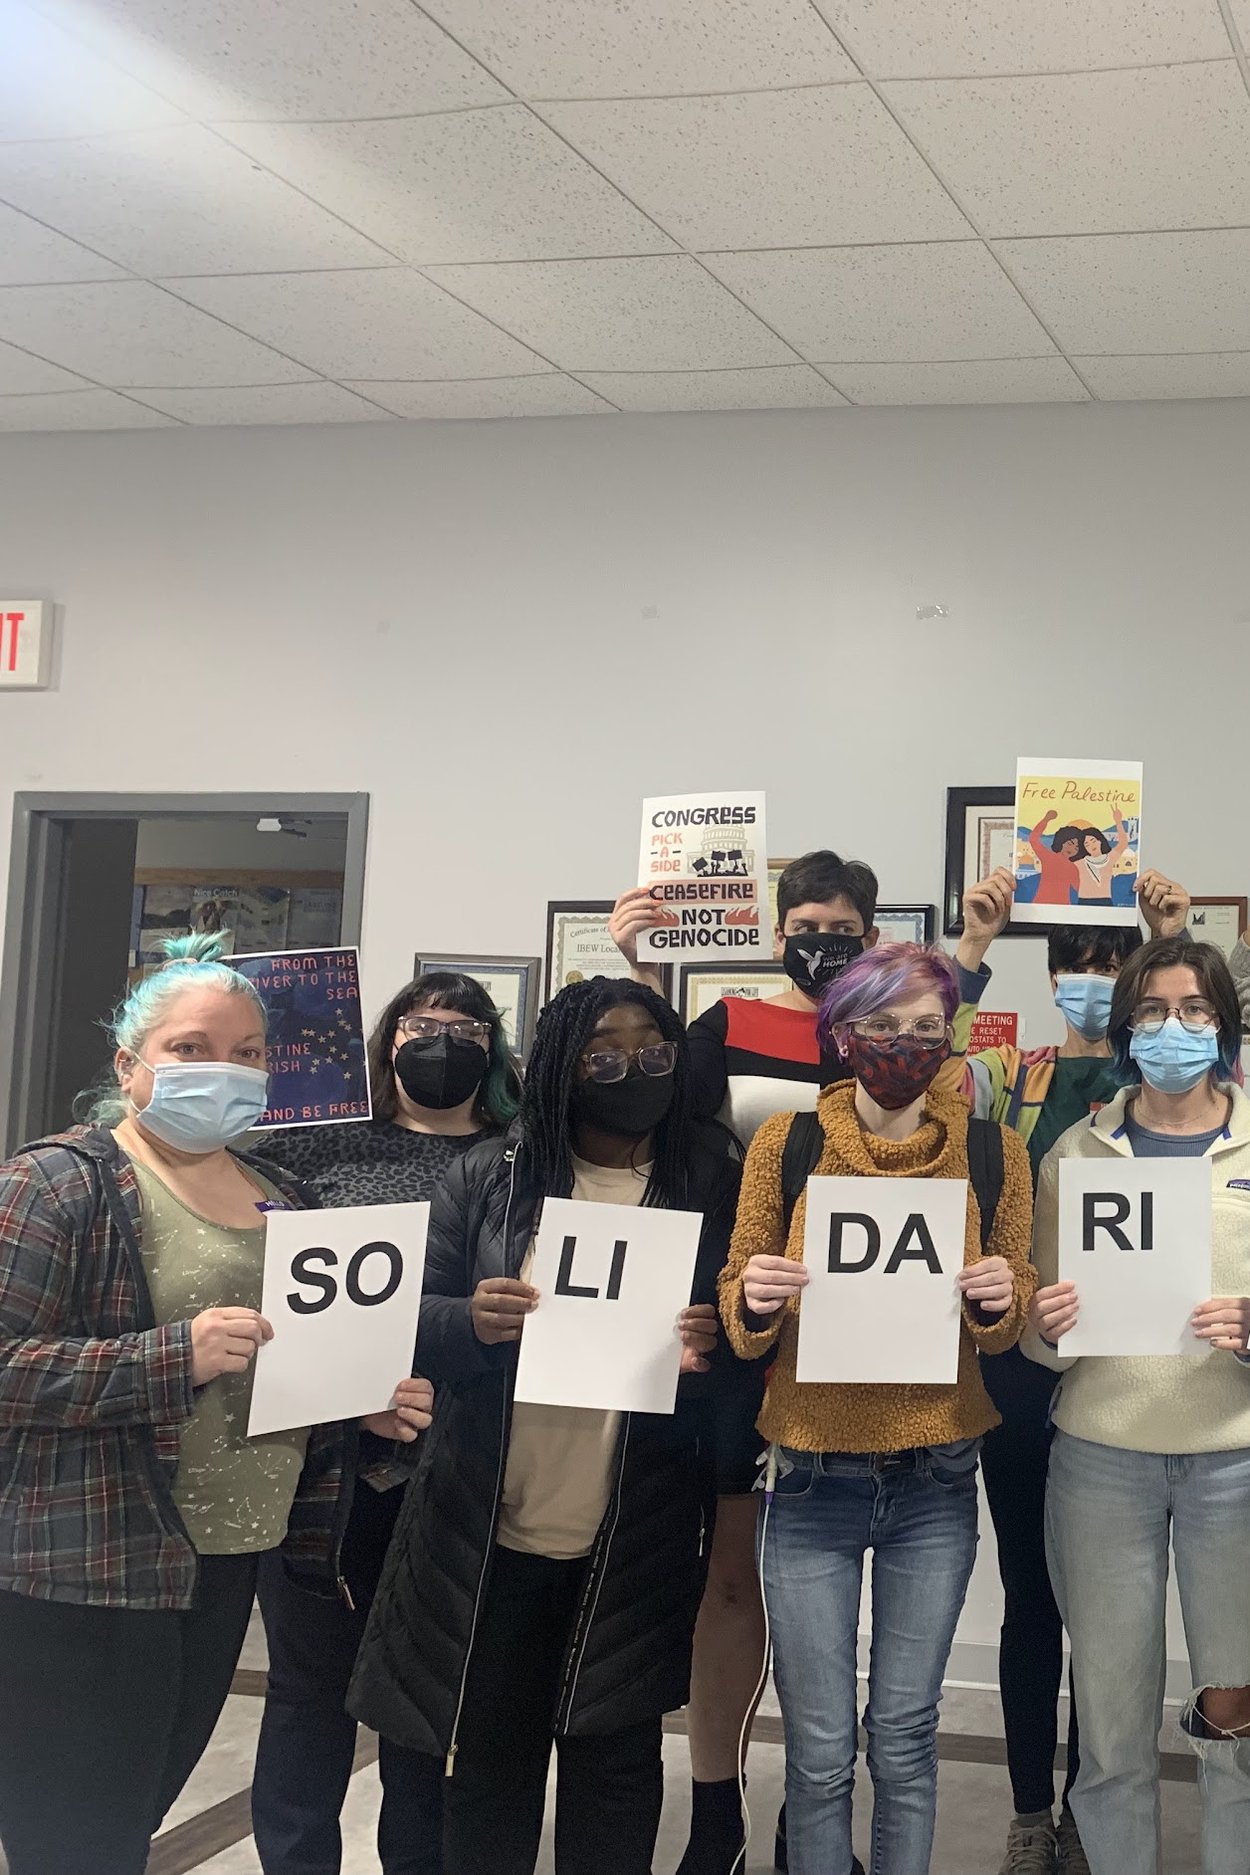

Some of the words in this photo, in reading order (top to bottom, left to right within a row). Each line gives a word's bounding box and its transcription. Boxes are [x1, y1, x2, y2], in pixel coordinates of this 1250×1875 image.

[1022, 782, 1056, 800] Free
[1061, 780, 1136, 803] Palestine
[652, 806, 756, 828] CONGRESS
[651, 832, 683, 847] PICK
[651, 859, 681, 873] SIDE
[649, 883, 754, 901] CEASEFIRE
[682, 909, 726, 926] NOT
[649, 928, 760, 948] GENOCIDE
[577, 943, 599, 953] IBEW
[271, 956, 318, 971] FROM
[324, 954, 356, 968] THE
[823, 959, 848, 968] HOME
[298, 973, 319, 986] TO
[325, 970, 357, 984] THE
[326, 986, 358, 1000] SEA
[969, 1035, 995, 1044] OSTATS
[998, 1036, 1007, 1044] TO
[979, 1027, 1003, 1036] RESET
[260, 1107, 295, 1122] AND
[302, 1105, 322, 1119] BE
[329, 1101, 368, 1116] FREE
[1082, 1191, 1154, 1252] RI
[827, 1211, 944, 1275] DA
[553, 1235, 629, 1300] LI
[285, 1240, 405, 1315] SO
